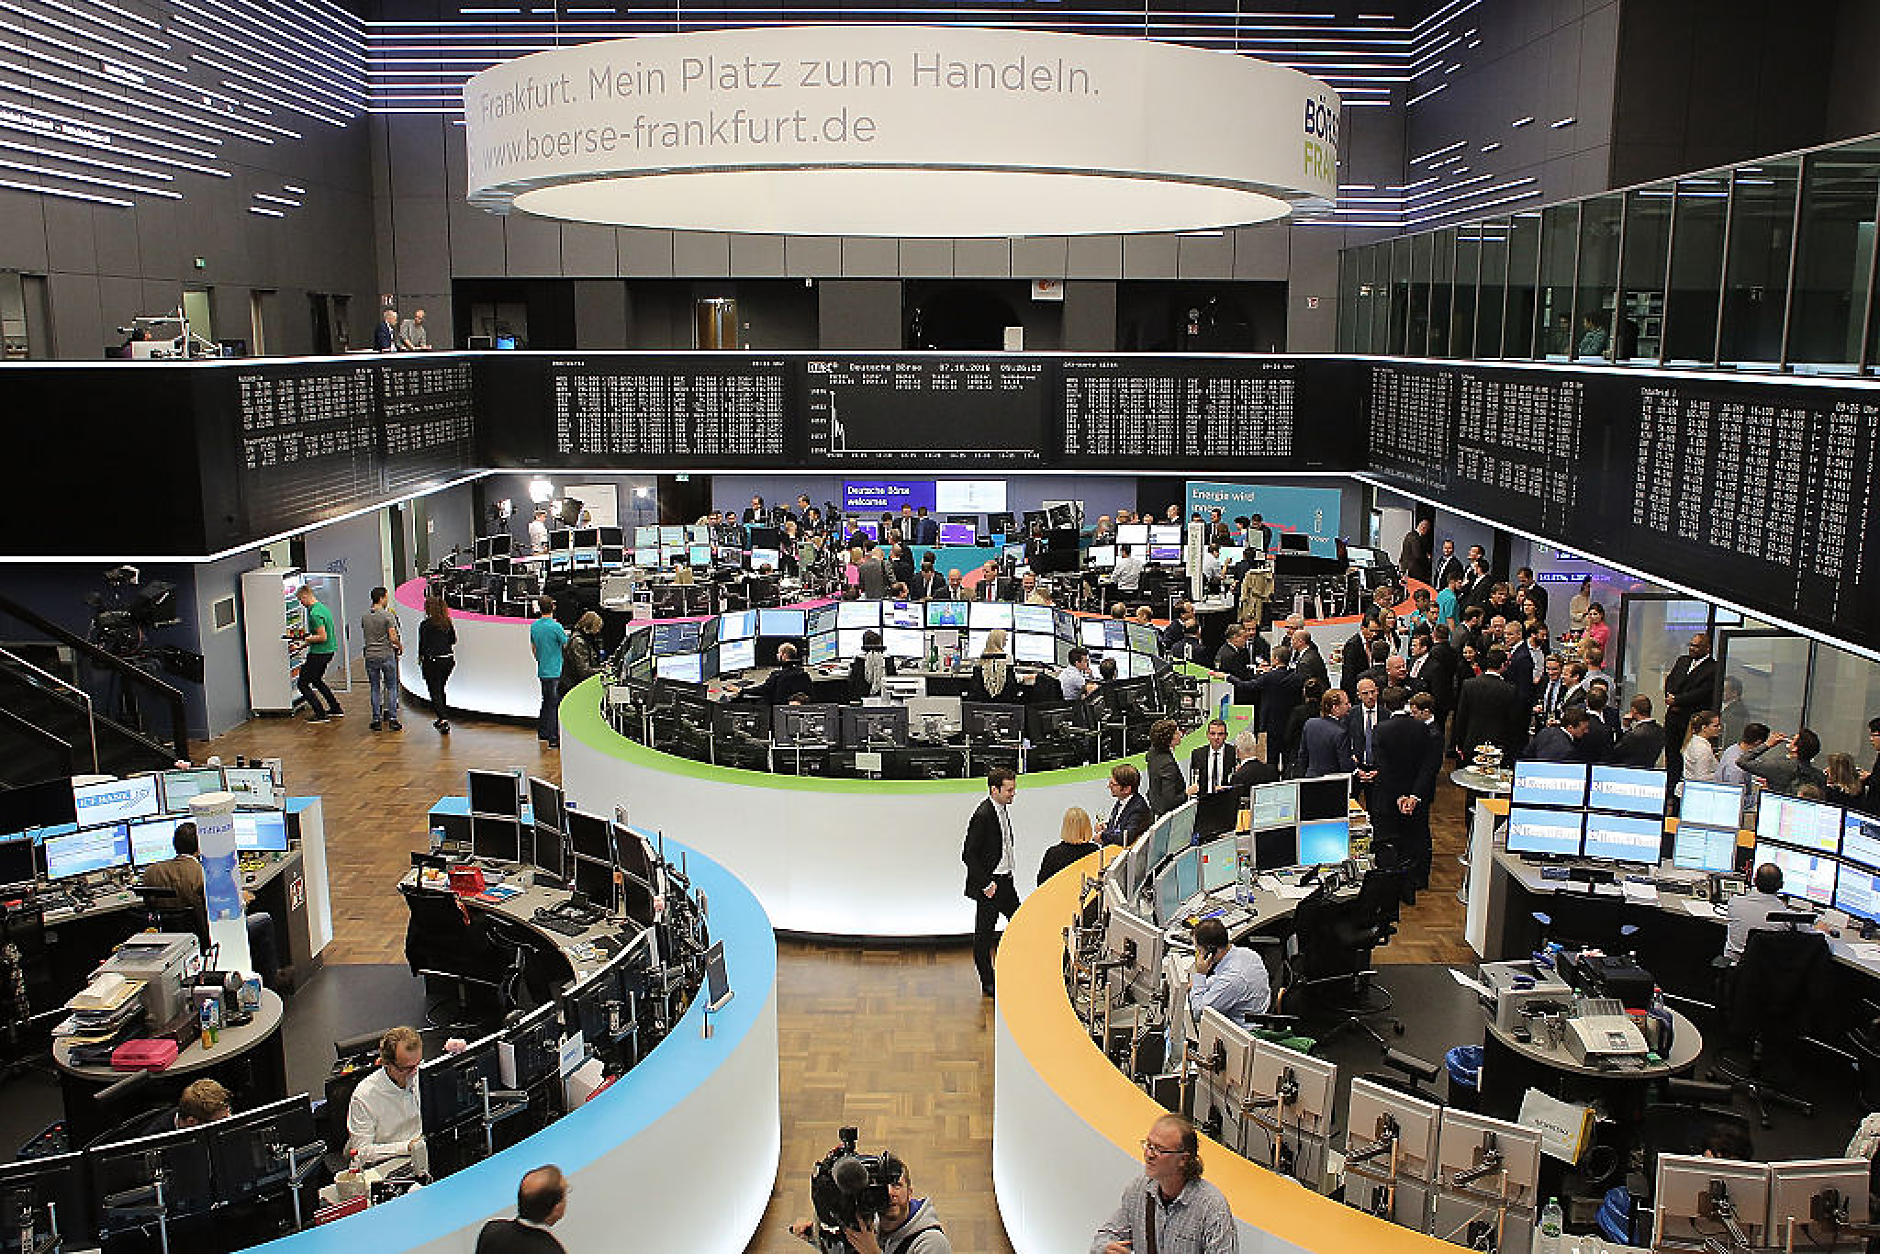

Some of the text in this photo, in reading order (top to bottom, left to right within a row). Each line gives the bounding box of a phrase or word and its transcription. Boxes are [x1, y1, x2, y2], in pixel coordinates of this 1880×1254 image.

[482, 52, 1100, 123] Frankfurt. Mein Platz zum Handeln.
[484, 107, 877, 171] www.boerse-frankfurt.de
[847, 485, 910, 495] Deutsche Börse
[1192, 488, 1255, 502] Energie wird
[847, 497, 888, 506] welcomes
